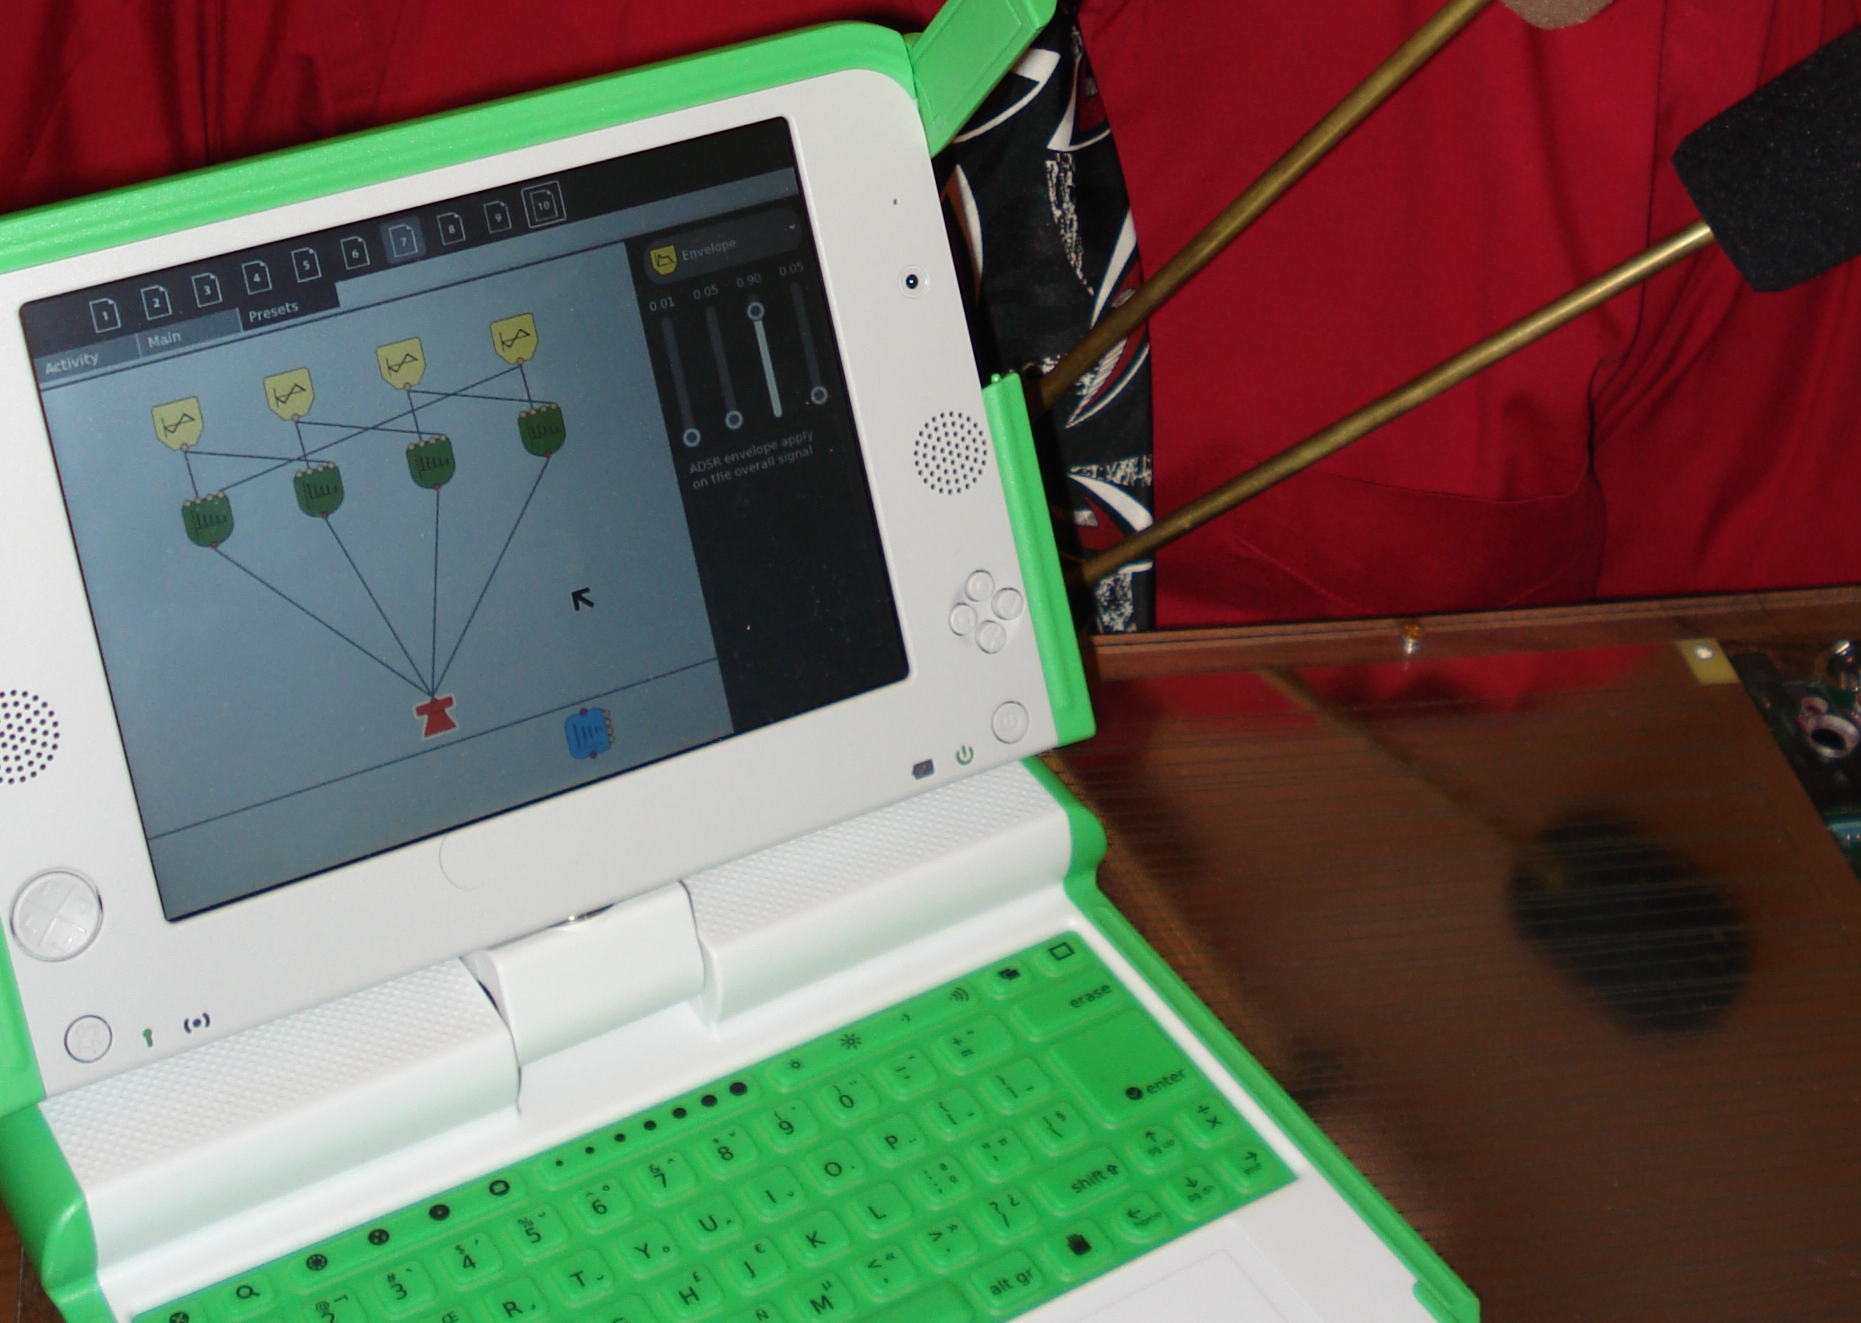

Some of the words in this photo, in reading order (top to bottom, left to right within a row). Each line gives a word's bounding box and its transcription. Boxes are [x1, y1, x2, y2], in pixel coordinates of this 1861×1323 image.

[537, 199, 551, 212] 10
[681, 238, 738, 262] Envelope
[778, 261, 805, 277] 0.05
[736, 273, 763, 289] 0.90
[692, 284, 720, 300] 0.05
[248, 301, 300, 323] Presets
[649, 296, 676, 312] 0.01
[147, 330, 182, 348] Main
[44, 352, 99, 375] Activity
[689, 456, 722, 474] ADSR
[724, 440, 779, 464] envelope
[781, 429, 814, 449] apply
[692, 476, 709, 490] on
[711, 468, 733, 485] the
[734, 454, 776, 478] overall
[777, 444, 814, 465] signal
[1069, 984, 1112, 1009] erase
[1146, 1069, 1186, 1095] enter
[778, 1120, 795, 1136] 9
[884, 1135, 898, 1150] P
[717, 1146, 734, 1162] 8
[653, 1173, 667, 1189] 7
[1071, 1170, 1108, 1194] shift
[592, 1199, 608, 1215] 6
[868, 1206, 887, 1220] L
[698, 1215, 719, 1232] U
[524, 1227, 542, 1244] 5
[805, 1231, 826, 1248] K
[634, 1242, 651, 1259] Y
[462, 1254, 477, 1270] 4
[744, 1260, 756, 1279] J
[568, 1270, 586, 1288] T
[989, 1278, 1014, 1296] alt
[1015, 1267, 1034, 1287] gr
[391, 1282, 408, 1301] 3
[678, 1286, 700, 1306] H
[503, 1300, 523, 1319] R
[810, 1295, 834, 1315] M
